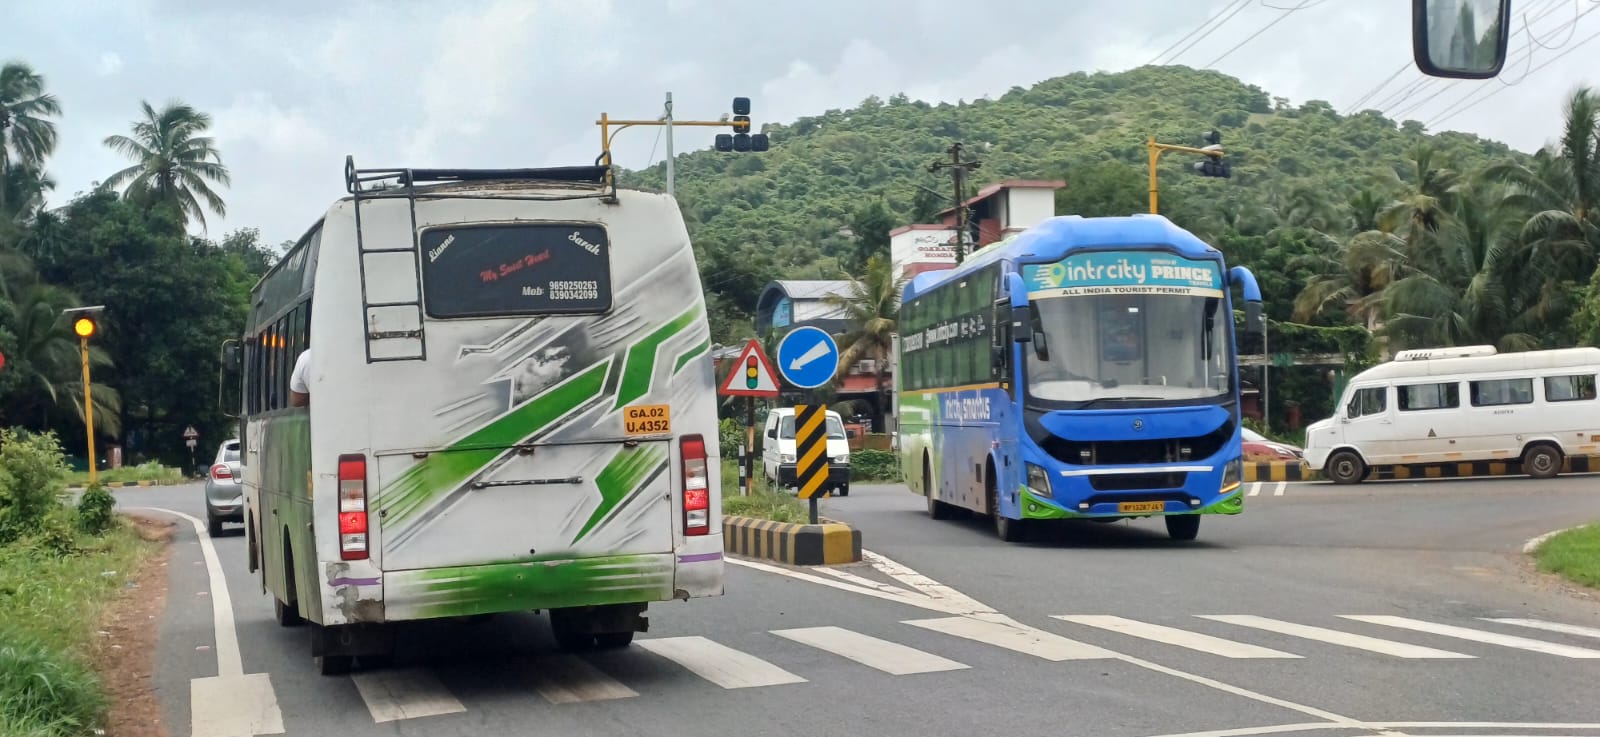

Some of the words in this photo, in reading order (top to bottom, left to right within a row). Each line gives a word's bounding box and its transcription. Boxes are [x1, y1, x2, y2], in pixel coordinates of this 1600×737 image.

[568, 231, 600, 256] Sarah
[1151, 266, 1211, 281] PRINCE
[1062, 288, 1081, 296] ALL
[1083, 287, 1111, 295] INDIA
[1156, 287, 1192, 295] PERMIT
[630, 408, 664, 418] GA.02
[626, 420, 669, 432] U.4352
